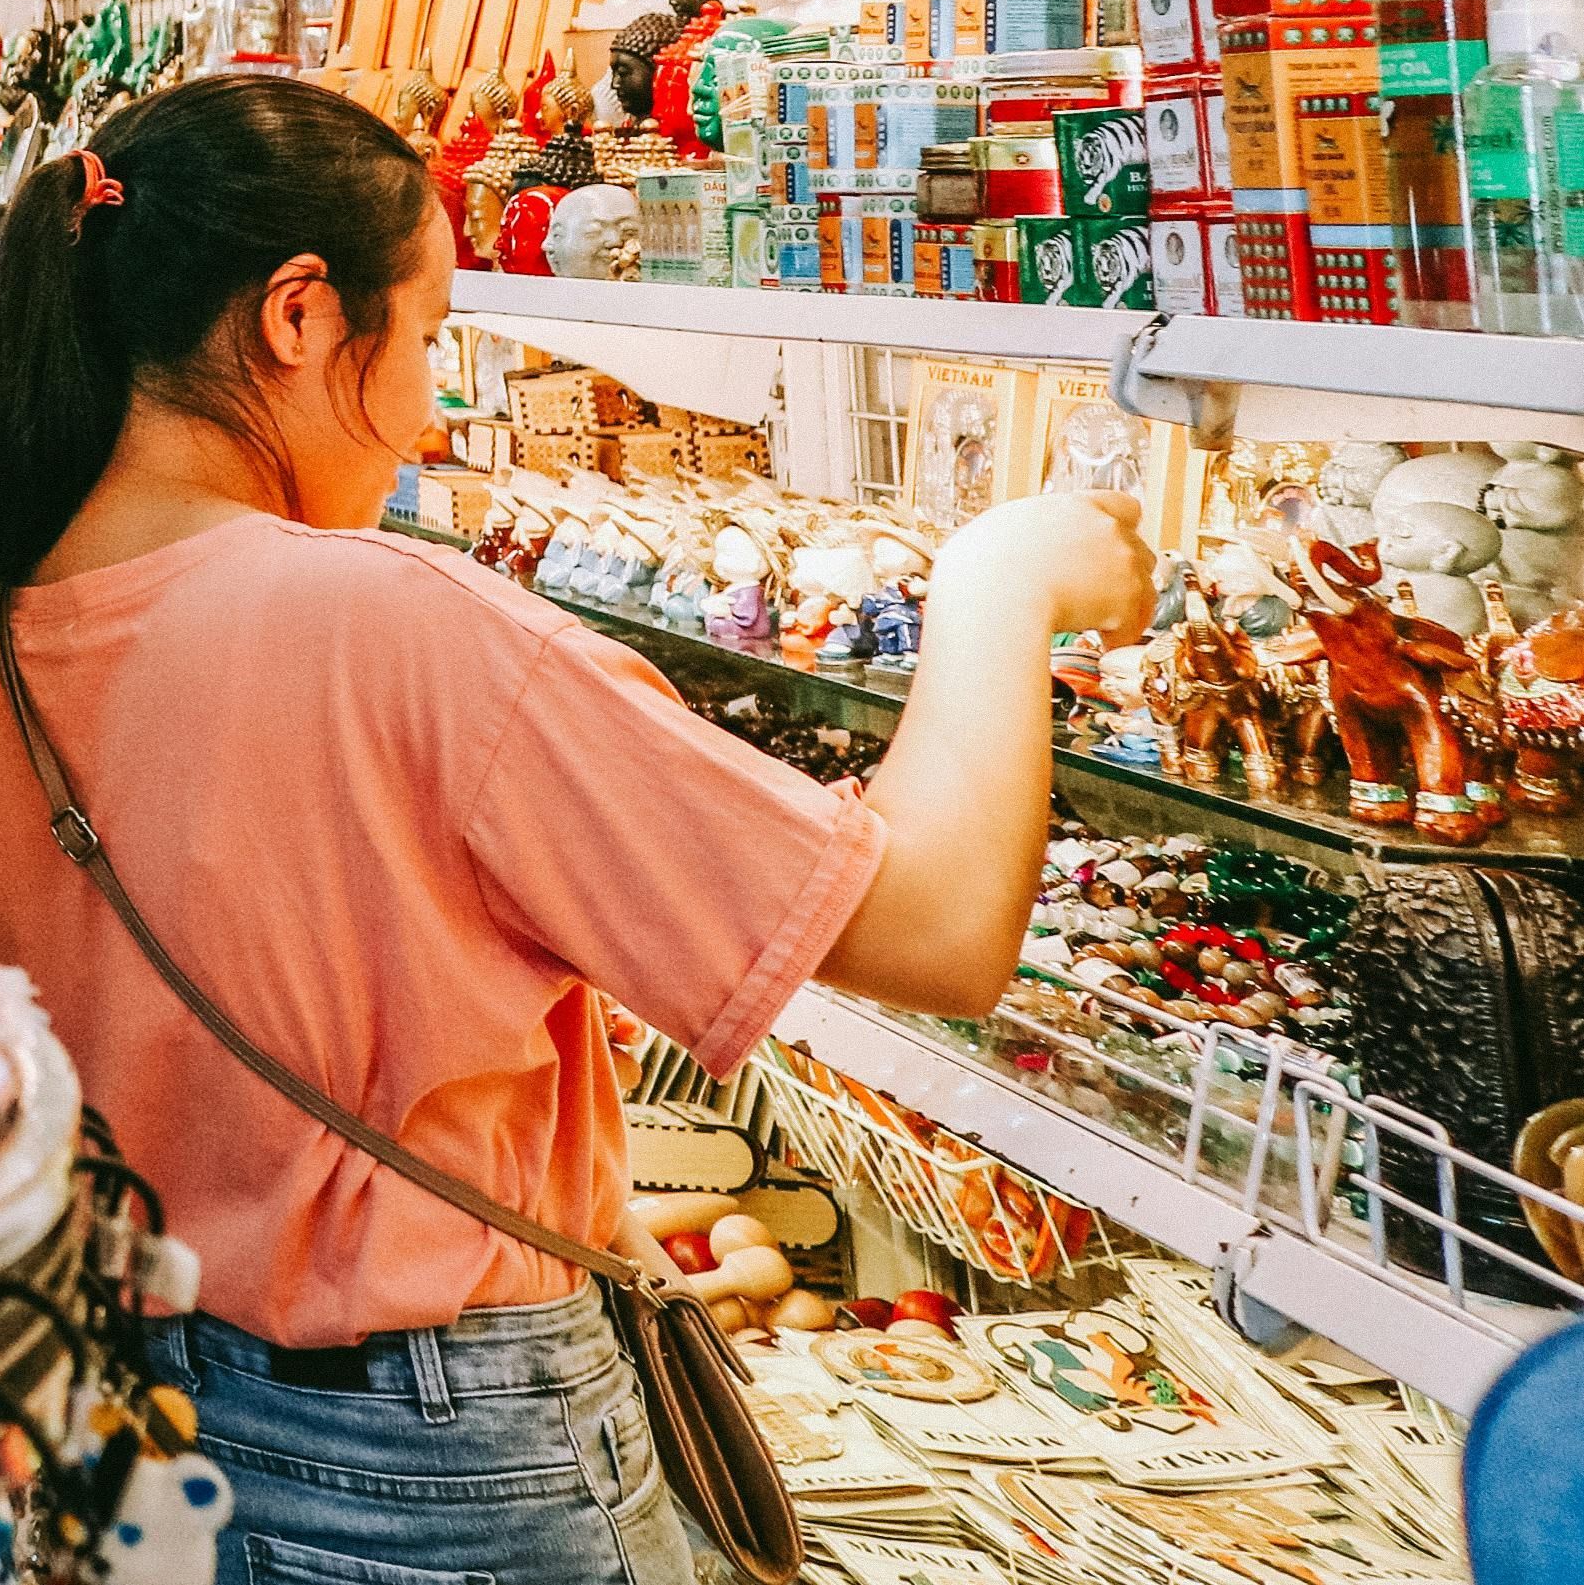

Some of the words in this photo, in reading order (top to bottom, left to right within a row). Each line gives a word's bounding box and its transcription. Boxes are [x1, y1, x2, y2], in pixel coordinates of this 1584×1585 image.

[927, 365, 995, 389] VIETNAM
[1137, 1447, 1284, 1470] MAGNET
[847, 1538, 981, 1573] MAGNET
